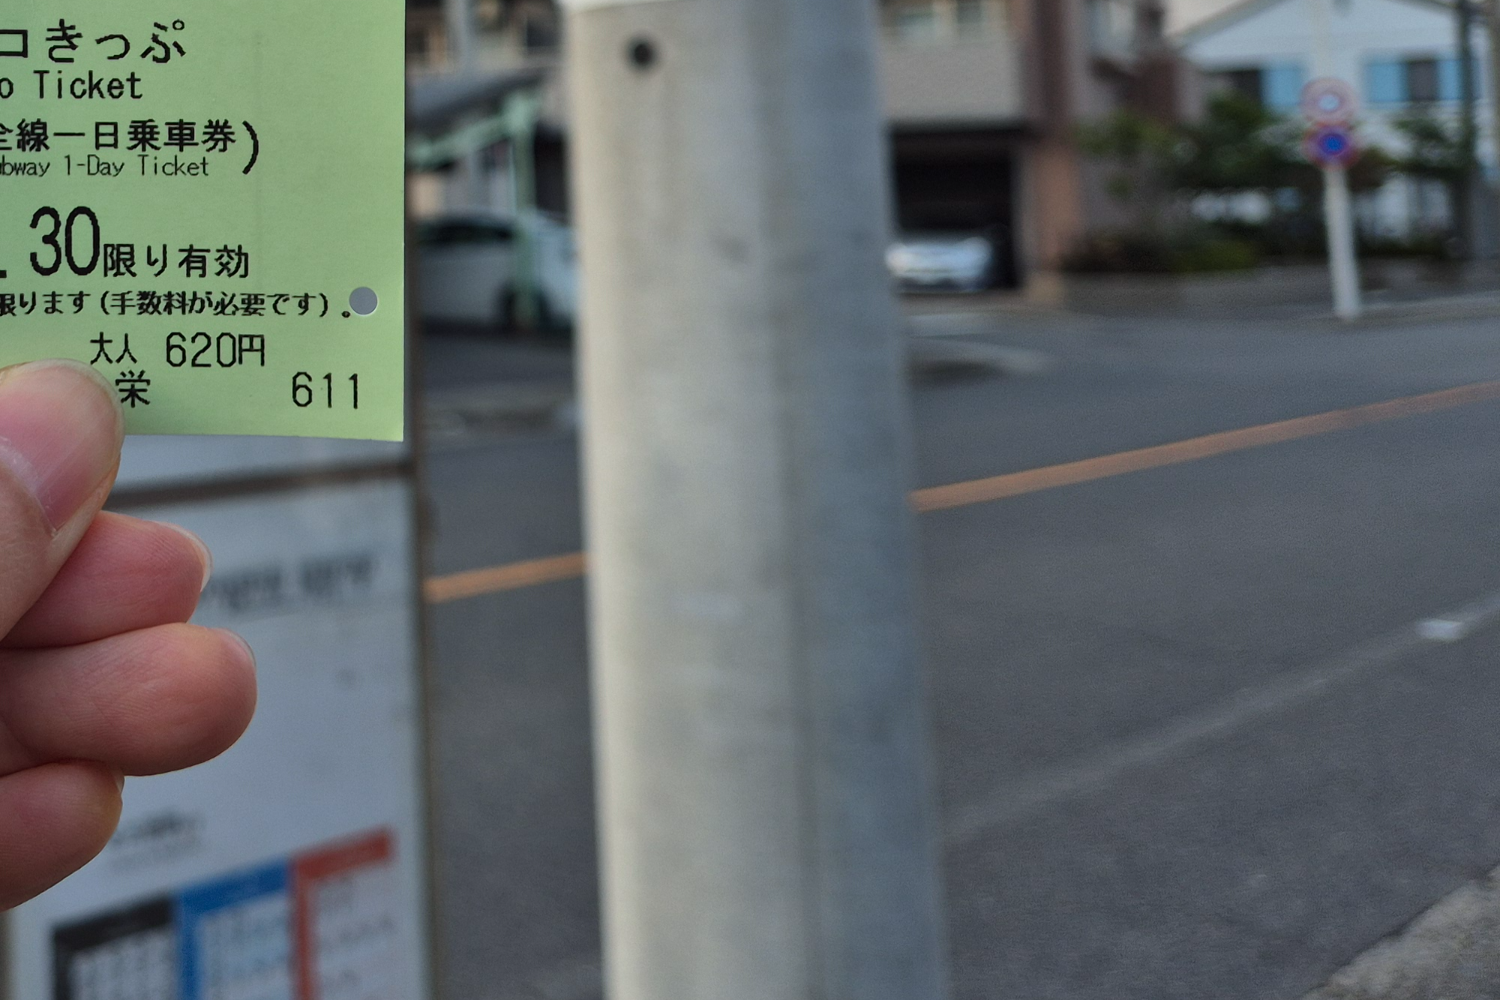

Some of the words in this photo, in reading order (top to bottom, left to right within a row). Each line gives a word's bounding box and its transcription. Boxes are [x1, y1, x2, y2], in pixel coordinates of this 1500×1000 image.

[33, 70, 143, 100] Ticket
[64, 154, 125, 178] 1-Day
[138, 154, 209, 177] Ticket
[90, 332, 138, 366] 大人
[166, 332, 266, 368] 620円
[116, 370, 151, 409] 栄
[292, 372, 359, 410] 611
